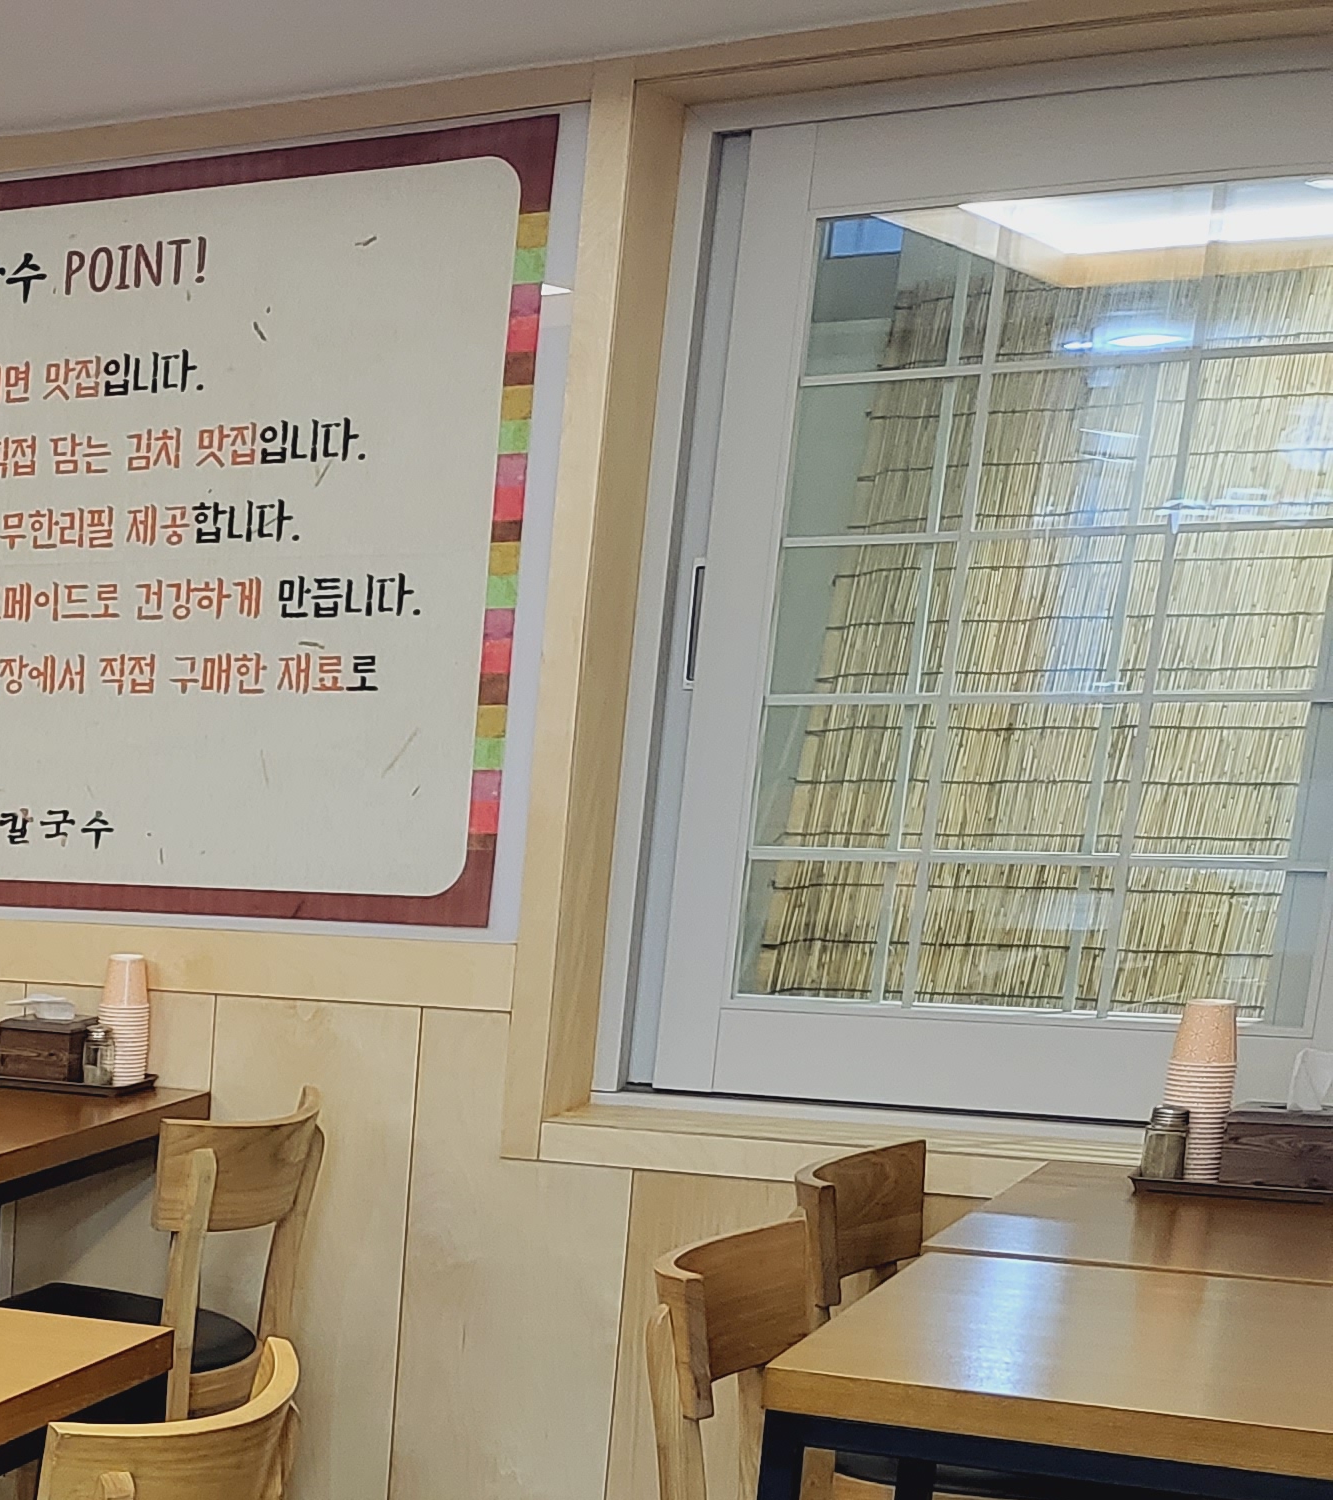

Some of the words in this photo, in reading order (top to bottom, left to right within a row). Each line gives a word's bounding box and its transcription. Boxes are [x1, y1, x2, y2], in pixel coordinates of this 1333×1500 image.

[65, 236, 206, 296] POINT!
[43, 349, 203, 400] 맛집입니다.
[49, 433, 111, 474] 담는
[127, 427, 181, 471] 김치
[196, 417, 365, 468] 맛집입니다.
[126, 499, 299, 546] 제공합니다.
[136, 577, 261, 620] 건강하게
[279, 573, 420, 618] 만듭니다.
[99, 654, 155, 695] 직접
[170, 653, 267, 694] 구매한
[277, 653, 378, 694] 재료로
[0, 808, 114, 849] 칼국수
